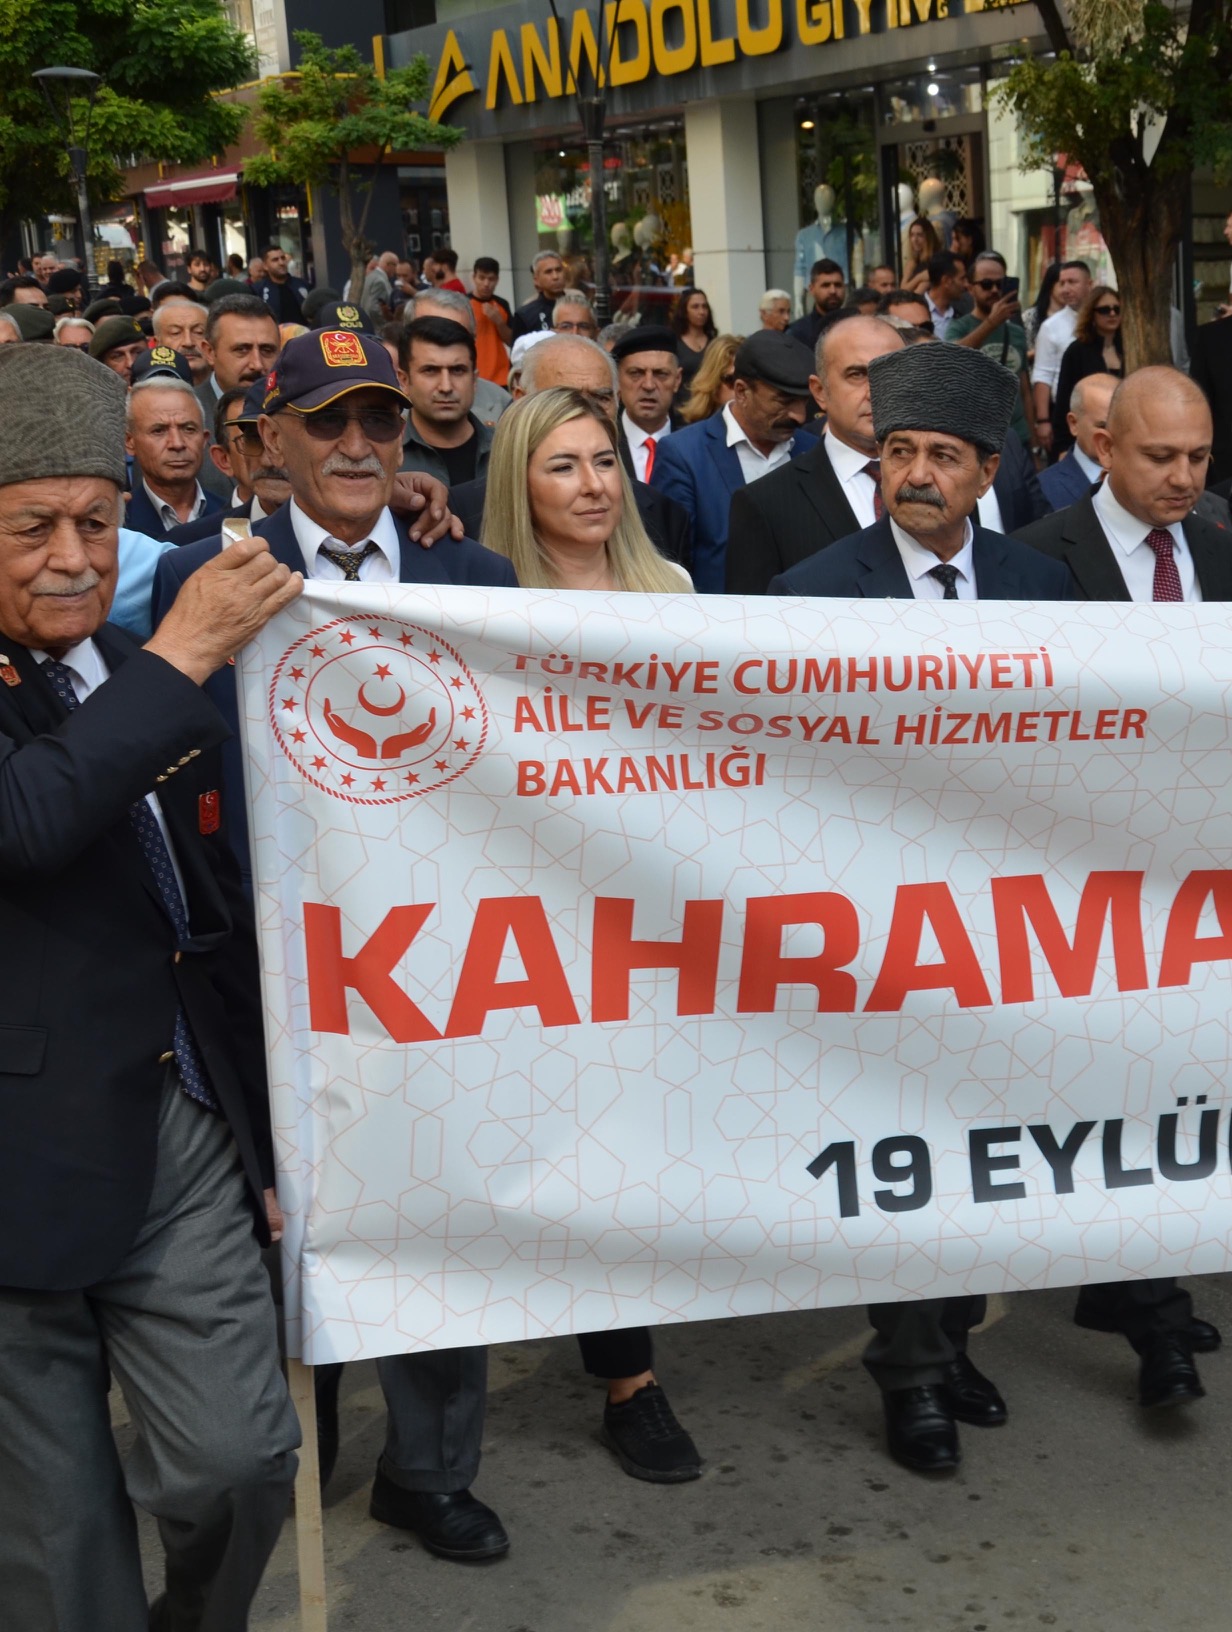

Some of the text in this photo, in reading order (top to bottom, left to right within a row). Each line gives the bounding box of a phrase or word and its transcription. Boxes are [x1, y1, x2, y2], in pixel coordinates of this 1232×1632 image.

[485, 0, 783, 110] ANADOLU
[507, 645, 1056, 697] TÜRKİYE CUMHURİYETİ
[514, 685, 1149, 746] AİLE VE SOSYAL HİZMETLER
[515, 745, 766, 798] BAKANLIĞI
[807, 1135, 933, 1218] 19
